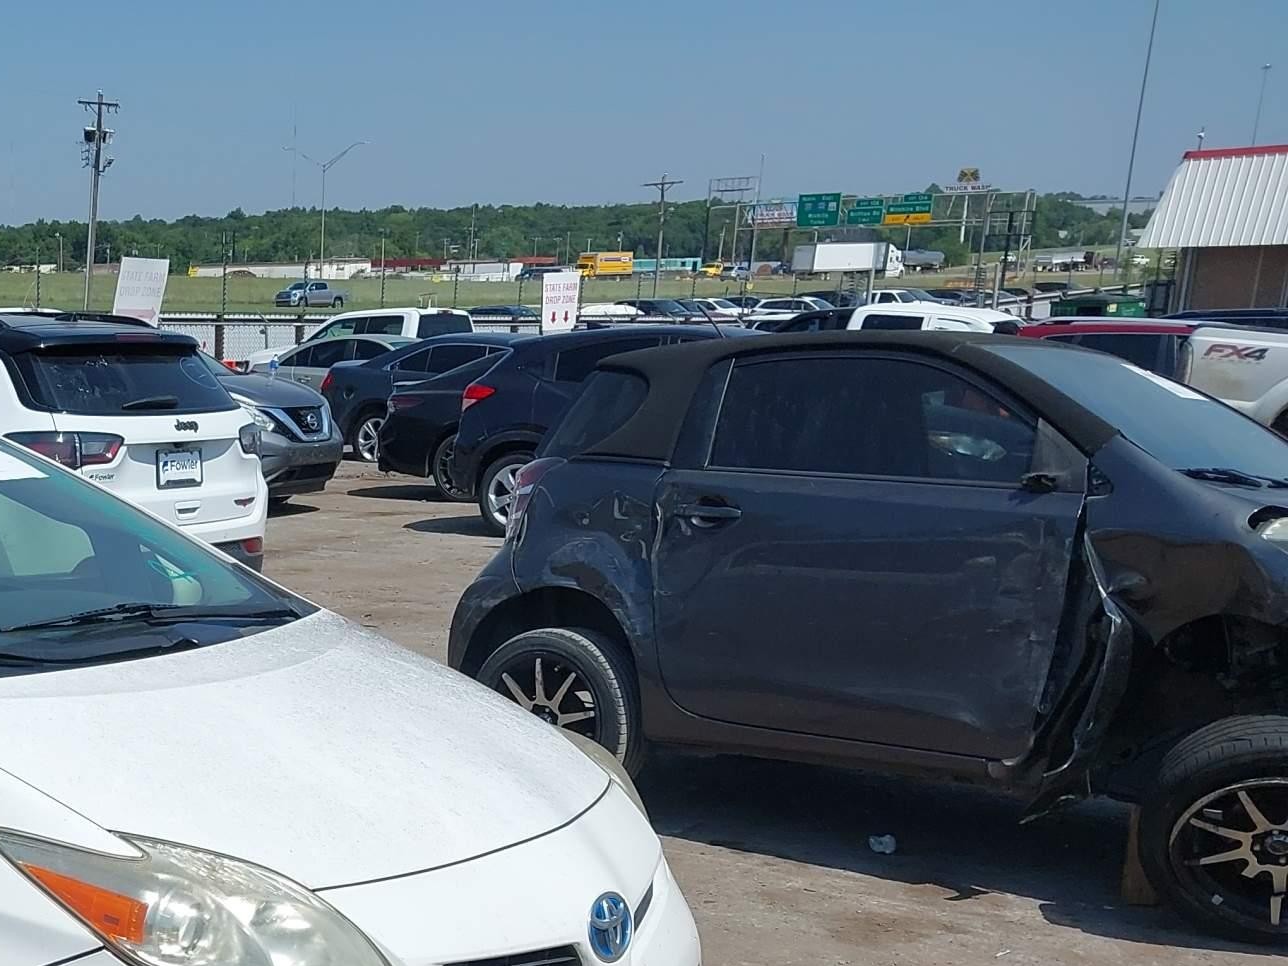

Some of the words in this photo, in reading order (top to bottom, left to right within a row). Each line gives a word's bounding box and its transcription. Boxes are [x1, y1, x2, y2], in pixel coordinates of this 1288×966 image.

[121, 271, 143, 281] STATE
[143, 271, 165, 282] FARM
[119, 286, 140, 296] DROP
[141, 287, 161, 297] ZONE
[544, 283, 562, 292] STATE
[562, 282, 578, 291] FARM
[545, 296, 561, 304] DROP
[561, 294, 576, 303] ZONE
[1203, 343, 1270, 361] FX4
[174, 418, 199, 433] Jeep
[170, 458, 198, 471] Fowler
[94, 473, 115, 481] Fowler
